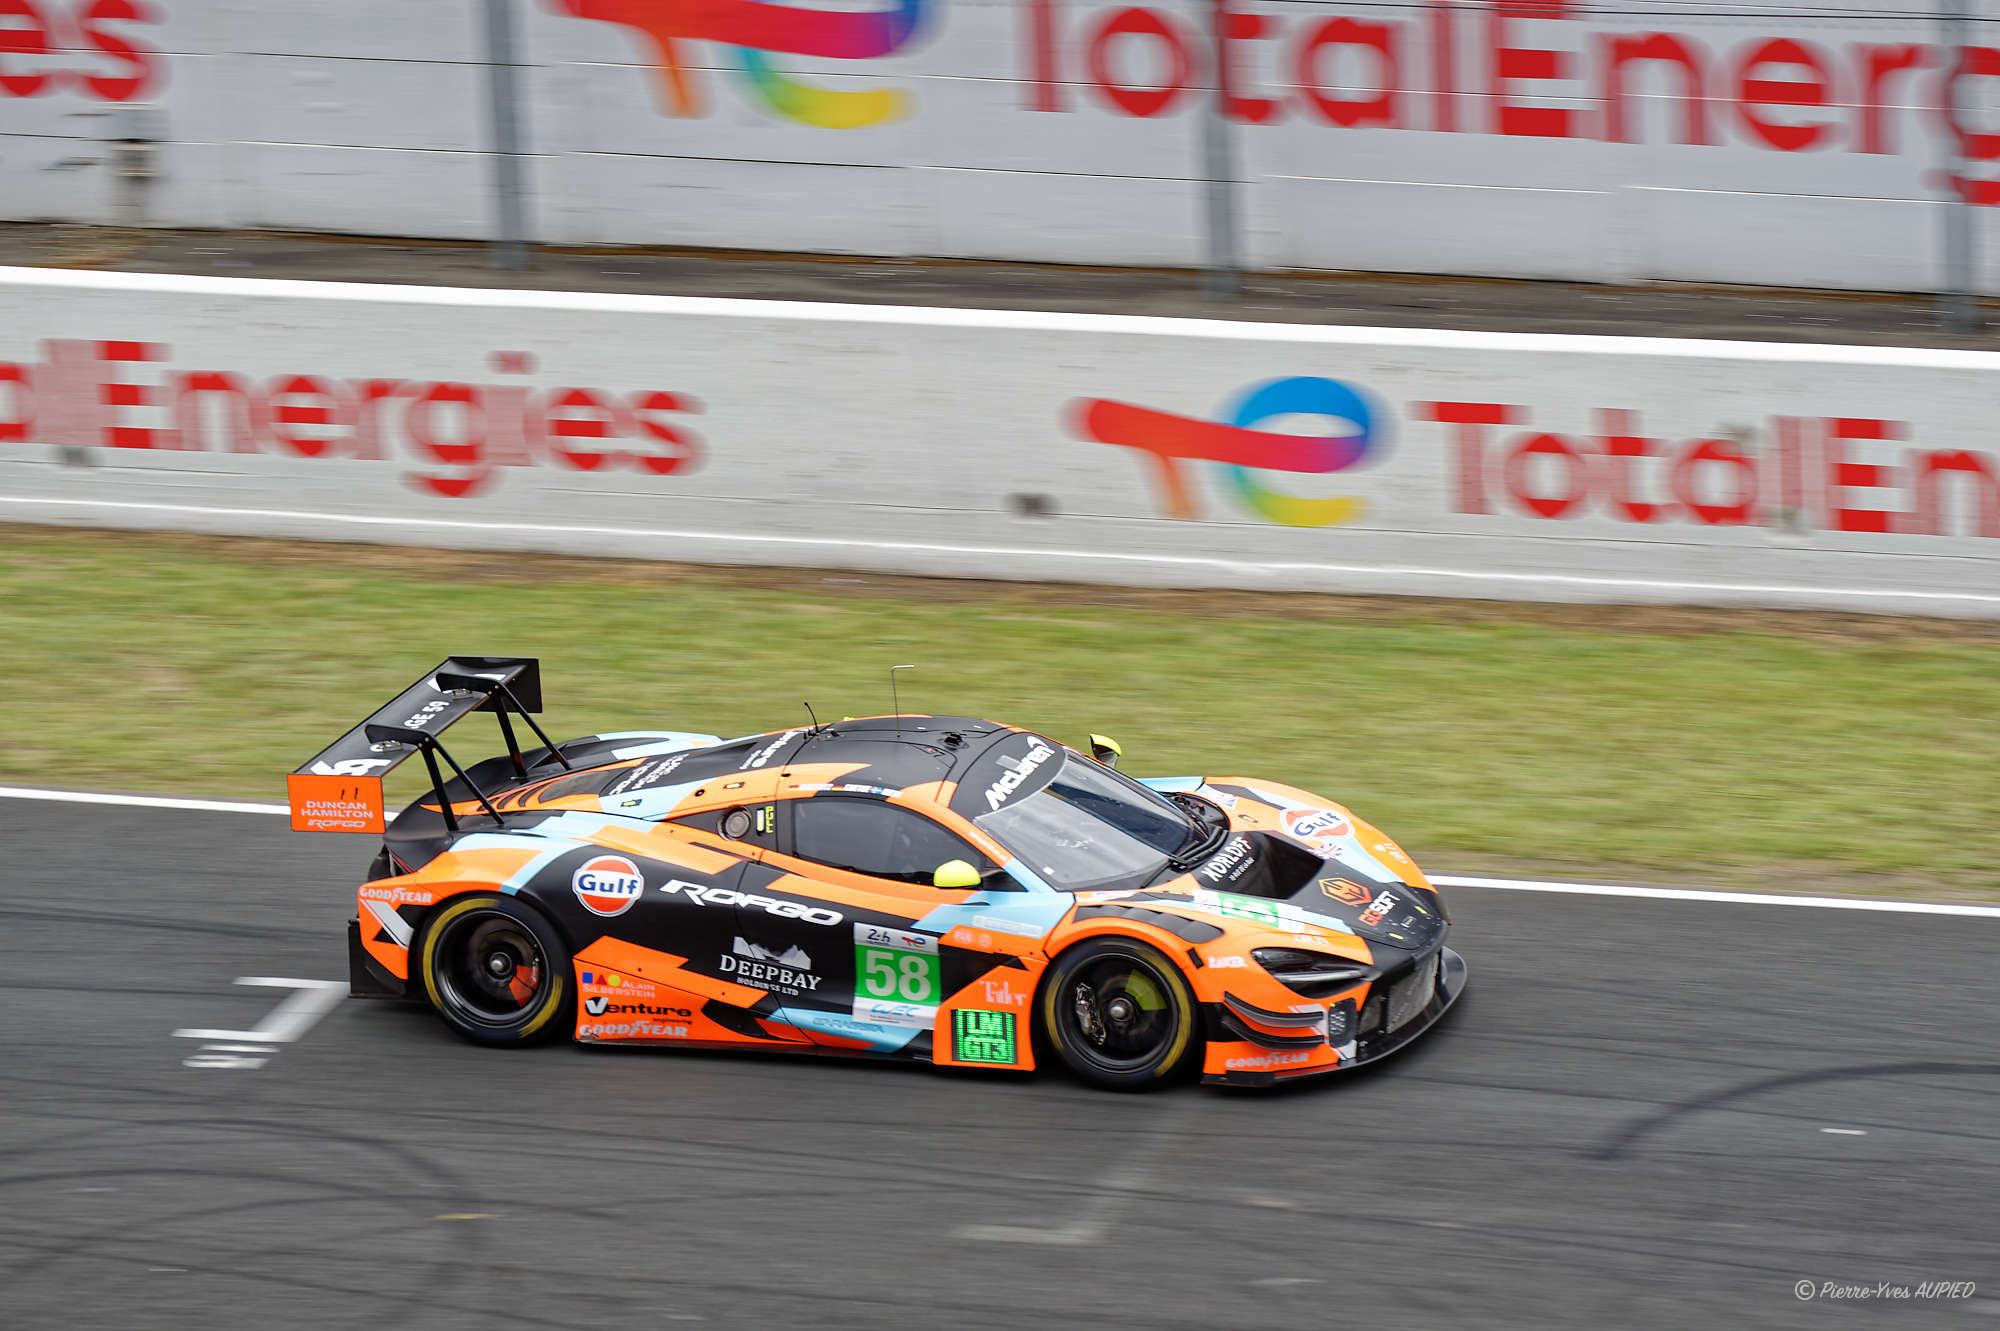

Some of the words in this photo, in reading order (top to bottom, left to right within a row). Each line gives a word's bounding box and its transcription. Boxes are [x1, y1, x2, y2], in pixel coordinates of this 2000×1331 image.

[422, 701, 450, 713] 59
[984, 745, 1056, 811] McLaren
[301, 808, 373, 818] HAMILTON
[306, 801, 367, 810] DUNCAN
[1293, 811, 1341, 837] Gulf
[578, 873, 638, 895] Gulf
[359, 886, 432, 903] GOODYEAR
[659, 879, 844, 926] ROFGO
[719, 954, 822, 990] DEEPBAY
[865, 949, 932, 1001] 58
[582, 984, 655, 998] SILBERSTEIN
[621, 980, 655, 991] ALAIN
[781, 986, 799, 996] LTD
[585, 997, 692, 1017] Venture
[579, 1020, 688, 1037] GOODYEAR
[966, 1011, 1004, 1035] LM
[963, 1037, 1009, 1060] GT3
